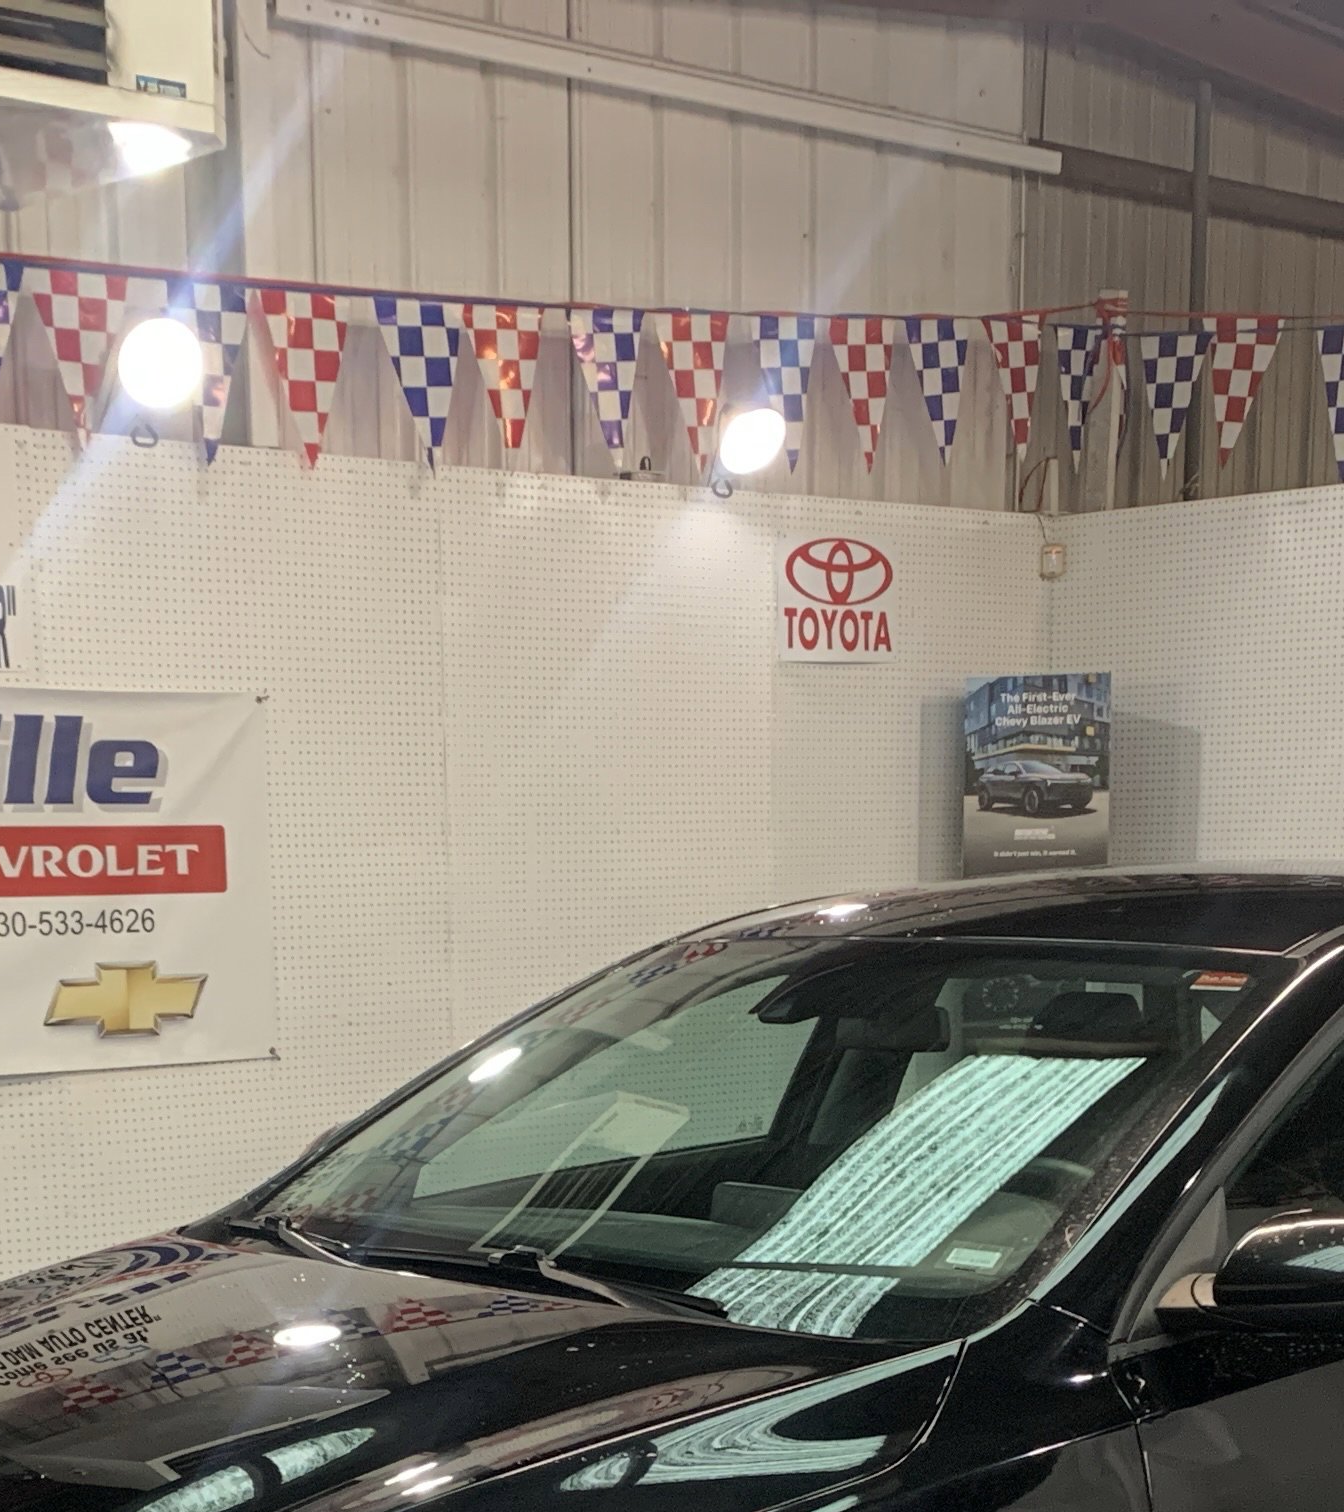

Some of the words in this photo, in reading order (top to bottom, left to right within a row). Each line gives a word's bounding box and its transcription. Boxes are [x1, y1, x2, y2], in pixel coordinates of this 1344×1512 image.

[784, 607, 892, 652] TOYOTA
[1000, 692, 1020, 703] The
[1022, 691, 1076, 702] First-Ever
[1007, 703, 1068, 714] All-Electric
[995, 716, 1028, 728] Chevy
[1030, 715, 1065, 726] Blazer
[1066, 713, 1081, 725] EV
